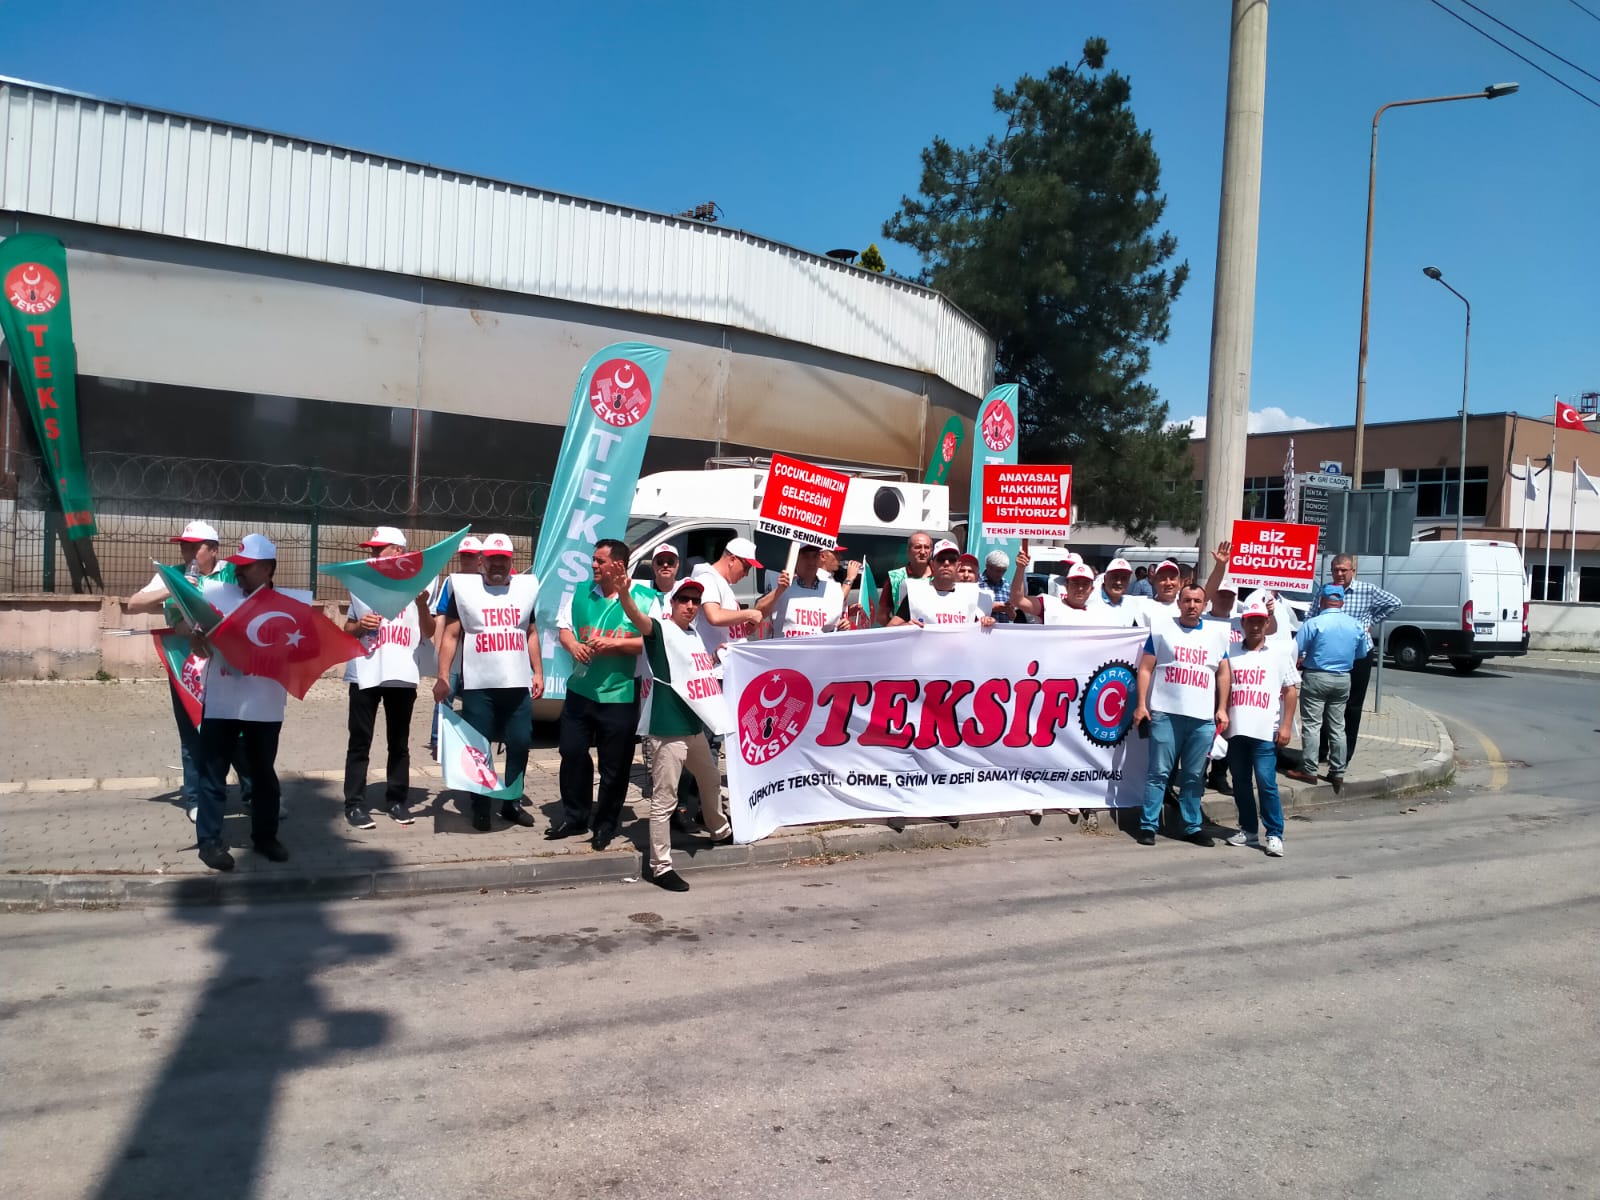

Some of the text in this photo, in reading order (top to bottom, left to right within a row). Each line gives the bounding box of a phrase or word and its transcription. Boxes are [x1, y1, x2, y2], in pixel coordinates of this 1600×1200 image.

[591, 390, 640, 426] TEKSİF
[983, 425, 1012, 451] TEKSİF
[774, 462, 846, 494] ÇOCUKLARIMIZIN
[998, 473, 1058, 482] ANAYASAL
[1000, 485, 1058, 494] HAKKIMIZ
[782, 485, 832, 509] GELECEĞİNİ
[986, 496, 1058, 506] KULLANMAK
[778, 501, 823, 526] İSTİYORUZ
[996, 505, 1058, 518] İSTİYORUZ
[759, 520, 835, 549] TEKSİF SENDİKASI
[986, 527, 1066, 537] TEKSİF SENDİKASI
[1259, 528, 1286, 543] BİZ
[1240, 541, 1303, 557] BİRLİKTE
[1231, 577, 1261, 586] TEKSİF
[481, 603, 521, 627] TEKSİF
[795, 607, 828, 628] TEKSİF
[1174, 645, 1208, 666] TEKSİF
[1164, 665, 1210, 690] SENDİKASI
[1233, 665, 1267, 686] TEKSİF
[814, 660, 1078, 750] TEKSİF
[1230, 686, 1271, 710] ENDİKASI
[741, 719, 799, 763] TEKSİF
[748, 780, 785, 810] TÜRKİYE
[787, 771, 842, 790] TEKSTİL,
[846, 771, 892, 789] ÖRME,
[896, 773, 928, 788] GİYİM
[931, 774, 947, 785] VE
[949, 769, 974, 785] DERİ
[977, 768, 1019, 783] SANAYİ
[1020, 768, 1069, 784] İŞÇİLERİ
